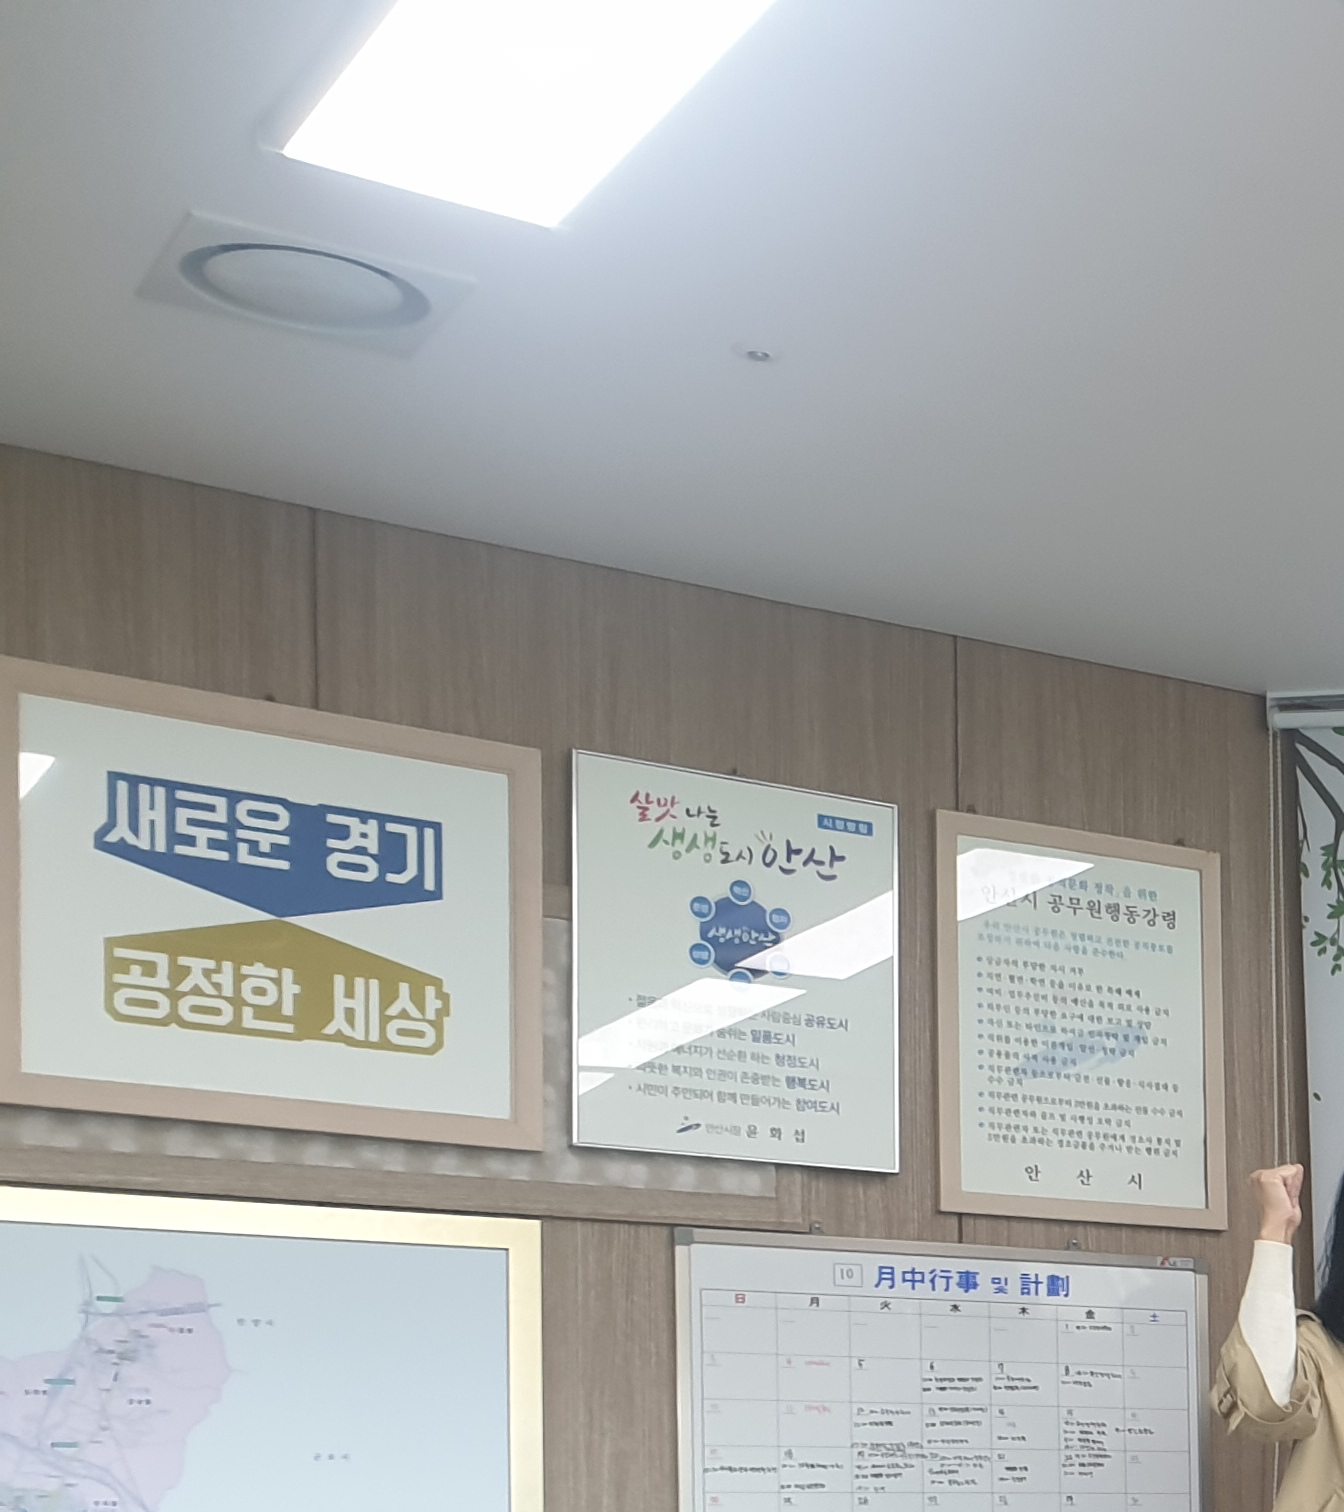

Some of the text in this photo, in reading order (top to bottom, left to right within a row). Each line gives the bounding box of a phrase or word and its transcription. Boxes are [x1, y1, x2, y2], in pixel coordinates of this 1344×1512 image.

[102, 780, 436, 892] 새로운 경기
[762, 839, 846, 881] 안산
[1046, 892, 1176, 930] 공무원행동강령
[113, 947, 443, 1052] 공정한 세상
[803, 1013, 848, 1032] 공유도시
[1025, 1165, 1143, 1190] 안 산 시
[840, 1268, 854, 1280] 10
[874, 1265, 1070, 1297] 月中行事 및 計劃
[735, 1293, 1160, 1322] 日 月 火 水 木 金 土
